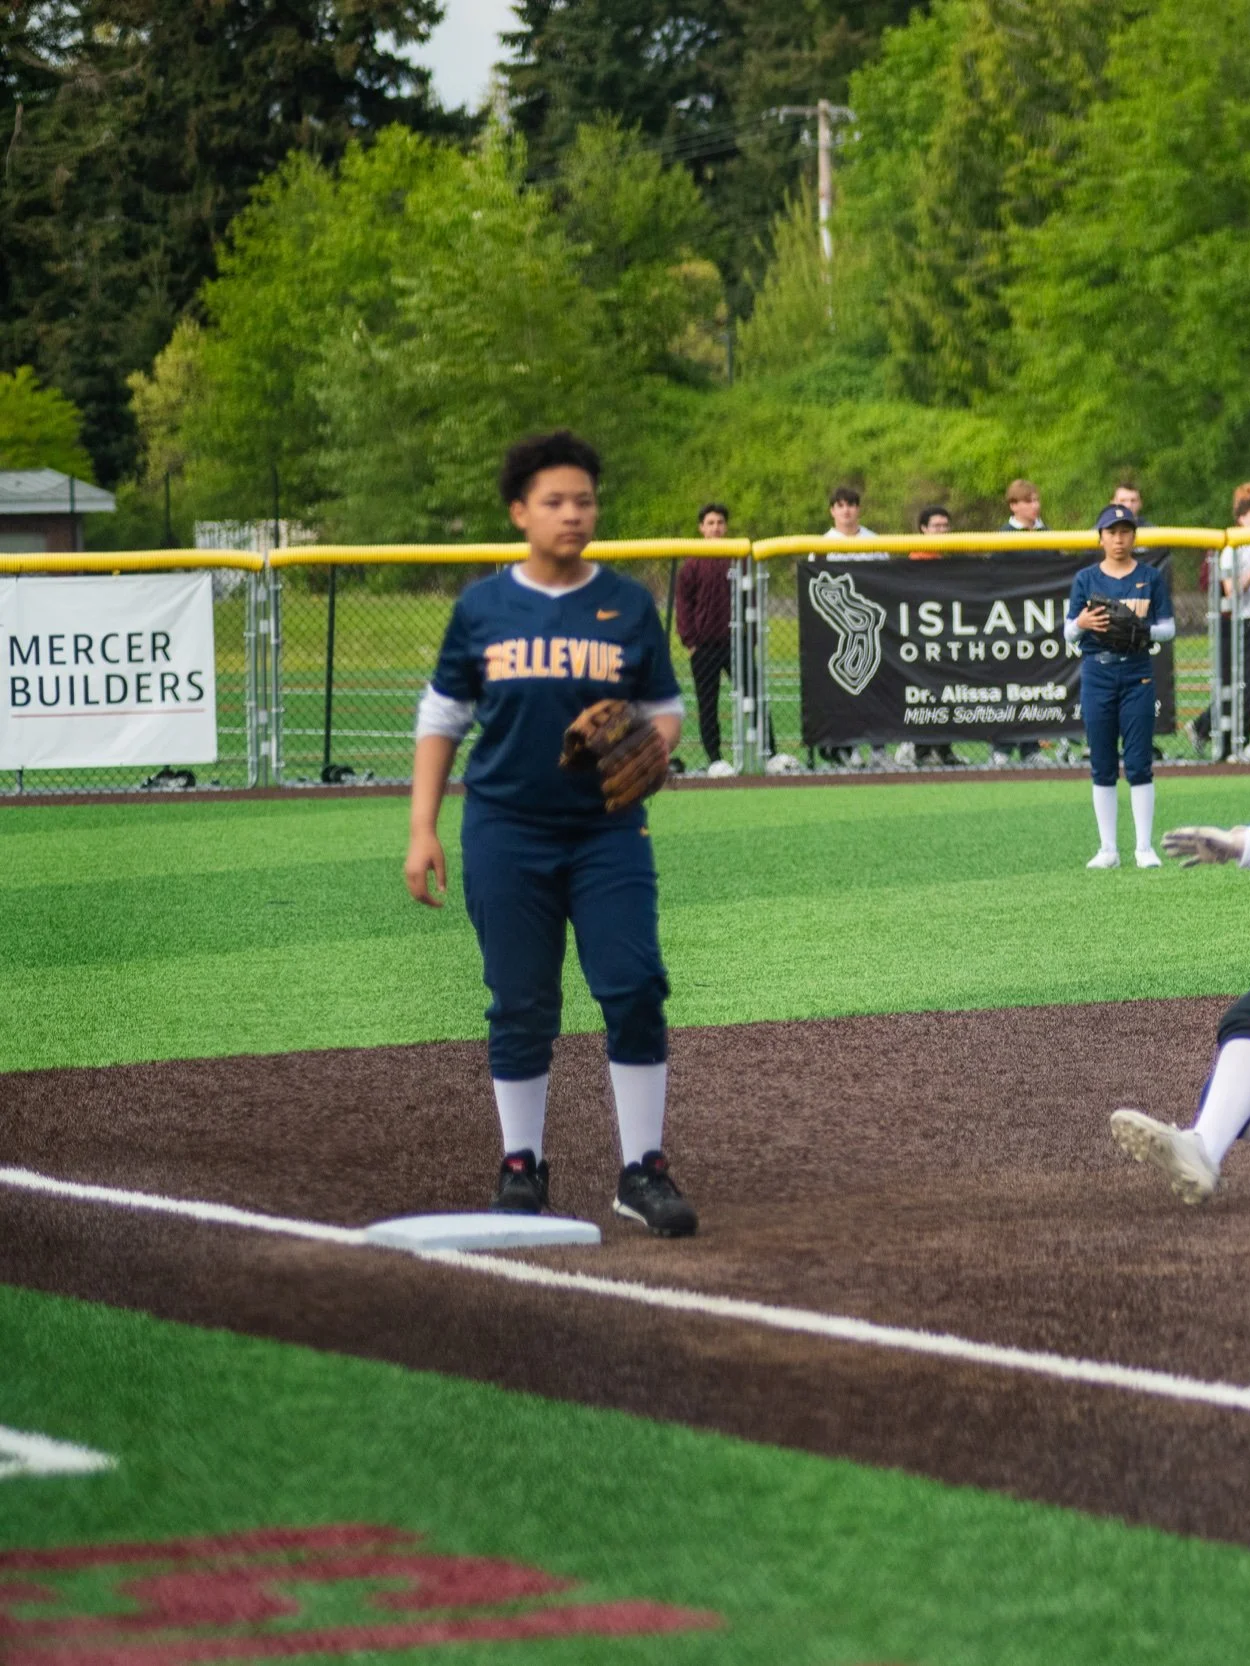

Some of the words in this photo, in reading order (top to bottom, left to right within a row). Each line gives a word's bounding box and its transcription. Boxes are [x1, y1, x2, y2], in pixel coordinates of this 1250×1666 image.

[8, 631, 171, 666] MERCER
[10, 671, 204, 707] BUILDERS
[905, 686, 936, 704] Dr.
[941, 684, 1002, 703] Alissa
[1006, 682, 1068, 701] Borda
[904, 707, 949, 724] MIHS
[953, 704, 1015, 723] Softball
